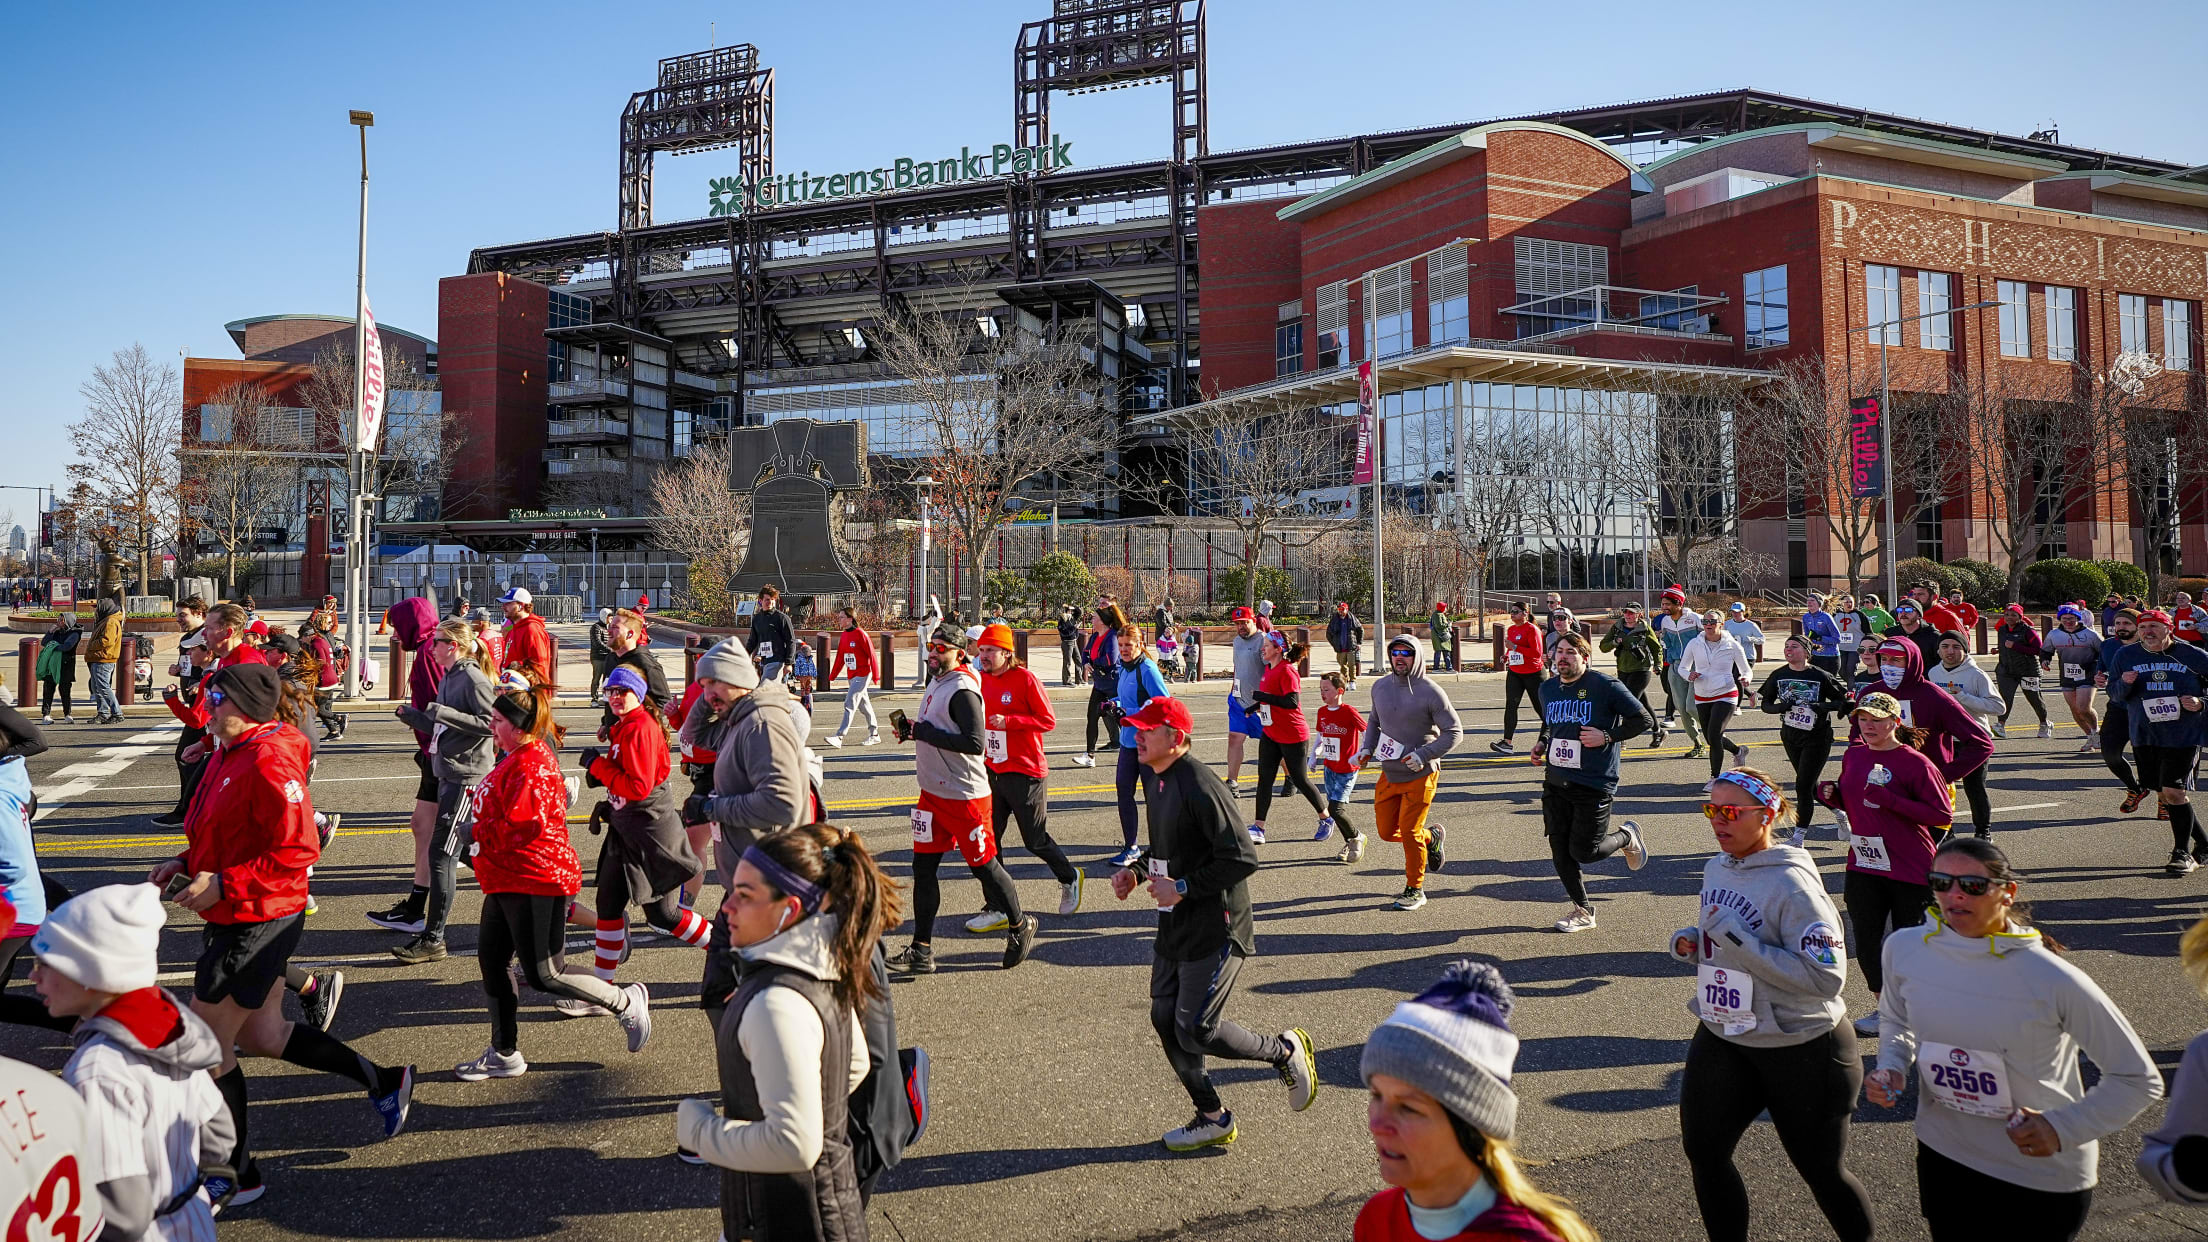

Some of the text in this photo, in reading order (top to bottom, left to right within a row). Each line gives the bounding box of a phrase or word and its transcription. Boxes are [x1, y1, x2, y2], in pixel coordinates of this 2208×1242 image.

[755, 133, 1073, 206] Citizens Bank Park
[1356, 431, 1368, 464] TURNER
[1851, 398, 1880, 495] Phillies
[257, 532, 278, 540] STORE
[532, 532, 547, 540] THIRD
[549, 532, 562, 540] BASE
[1840, 617, 1852, 631] P
[2146, 682, 2175, 690] UNION
[2149, 704, 2178, 714] 5005
[1789, 711, 1811, 724] 3328
[1380, 743, 1395, 757] 512
[1555, 747, 1574, 759] 390
[1857, 846, 1882, 859] 1524
[1705, 984, 1741, 1009] 1736
[1930, 1063, 1998, 1096] 2556
